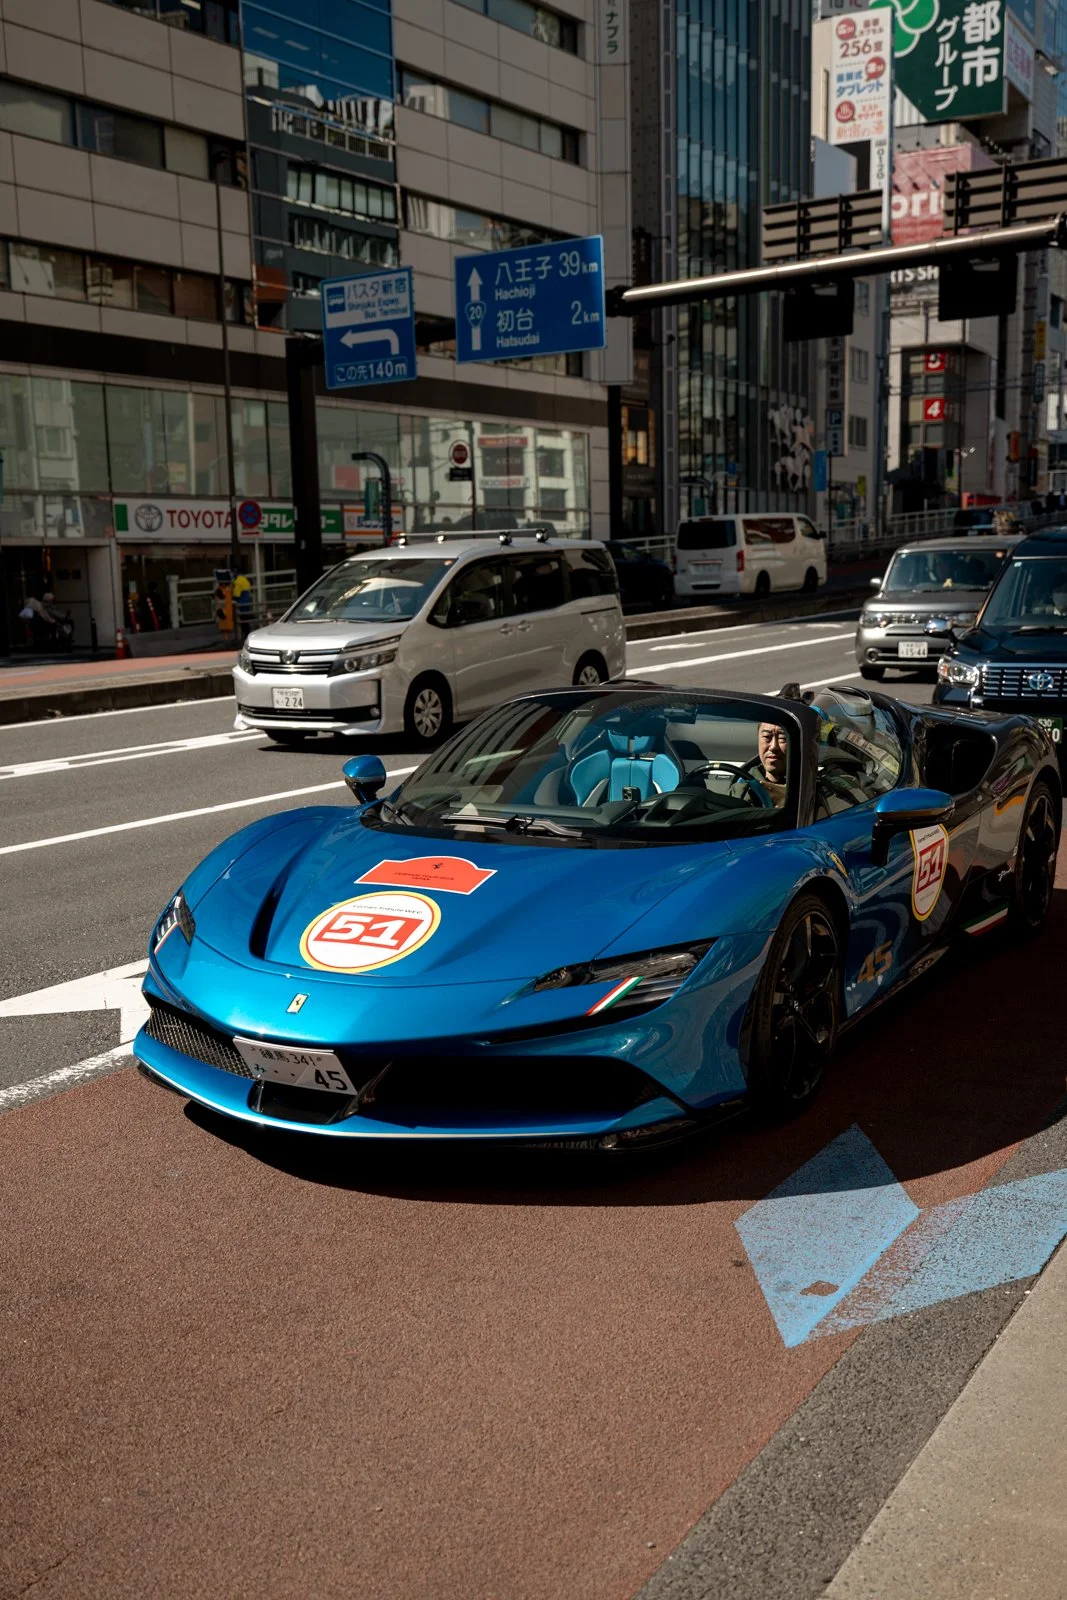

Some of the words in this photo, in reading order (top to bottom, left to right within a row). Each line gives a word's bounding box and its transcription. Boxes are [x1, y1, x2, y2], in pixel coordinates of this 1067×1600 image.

[962, 0, 1001, 87] 都市
[935, 15, 960, 111] グループ
[836, 80, 884, 98] タブレット
[495, 255, 553, 286] 八王子
[495, 284, 536, 301] Hachioji
[379, 307, 408, 318] Terminal
[469, 306, 482, 320] 20
[496, 308, 534, 332] 初台
[496, 332, 540, 349] Hatsudai
[926, 400, 941, 417] 4
[918, 846, 941, 888] 51
[321, 914, 406, 947] 51
[856, 940, 893, 985] 45
[314, 1069, 348, 1091] 45
